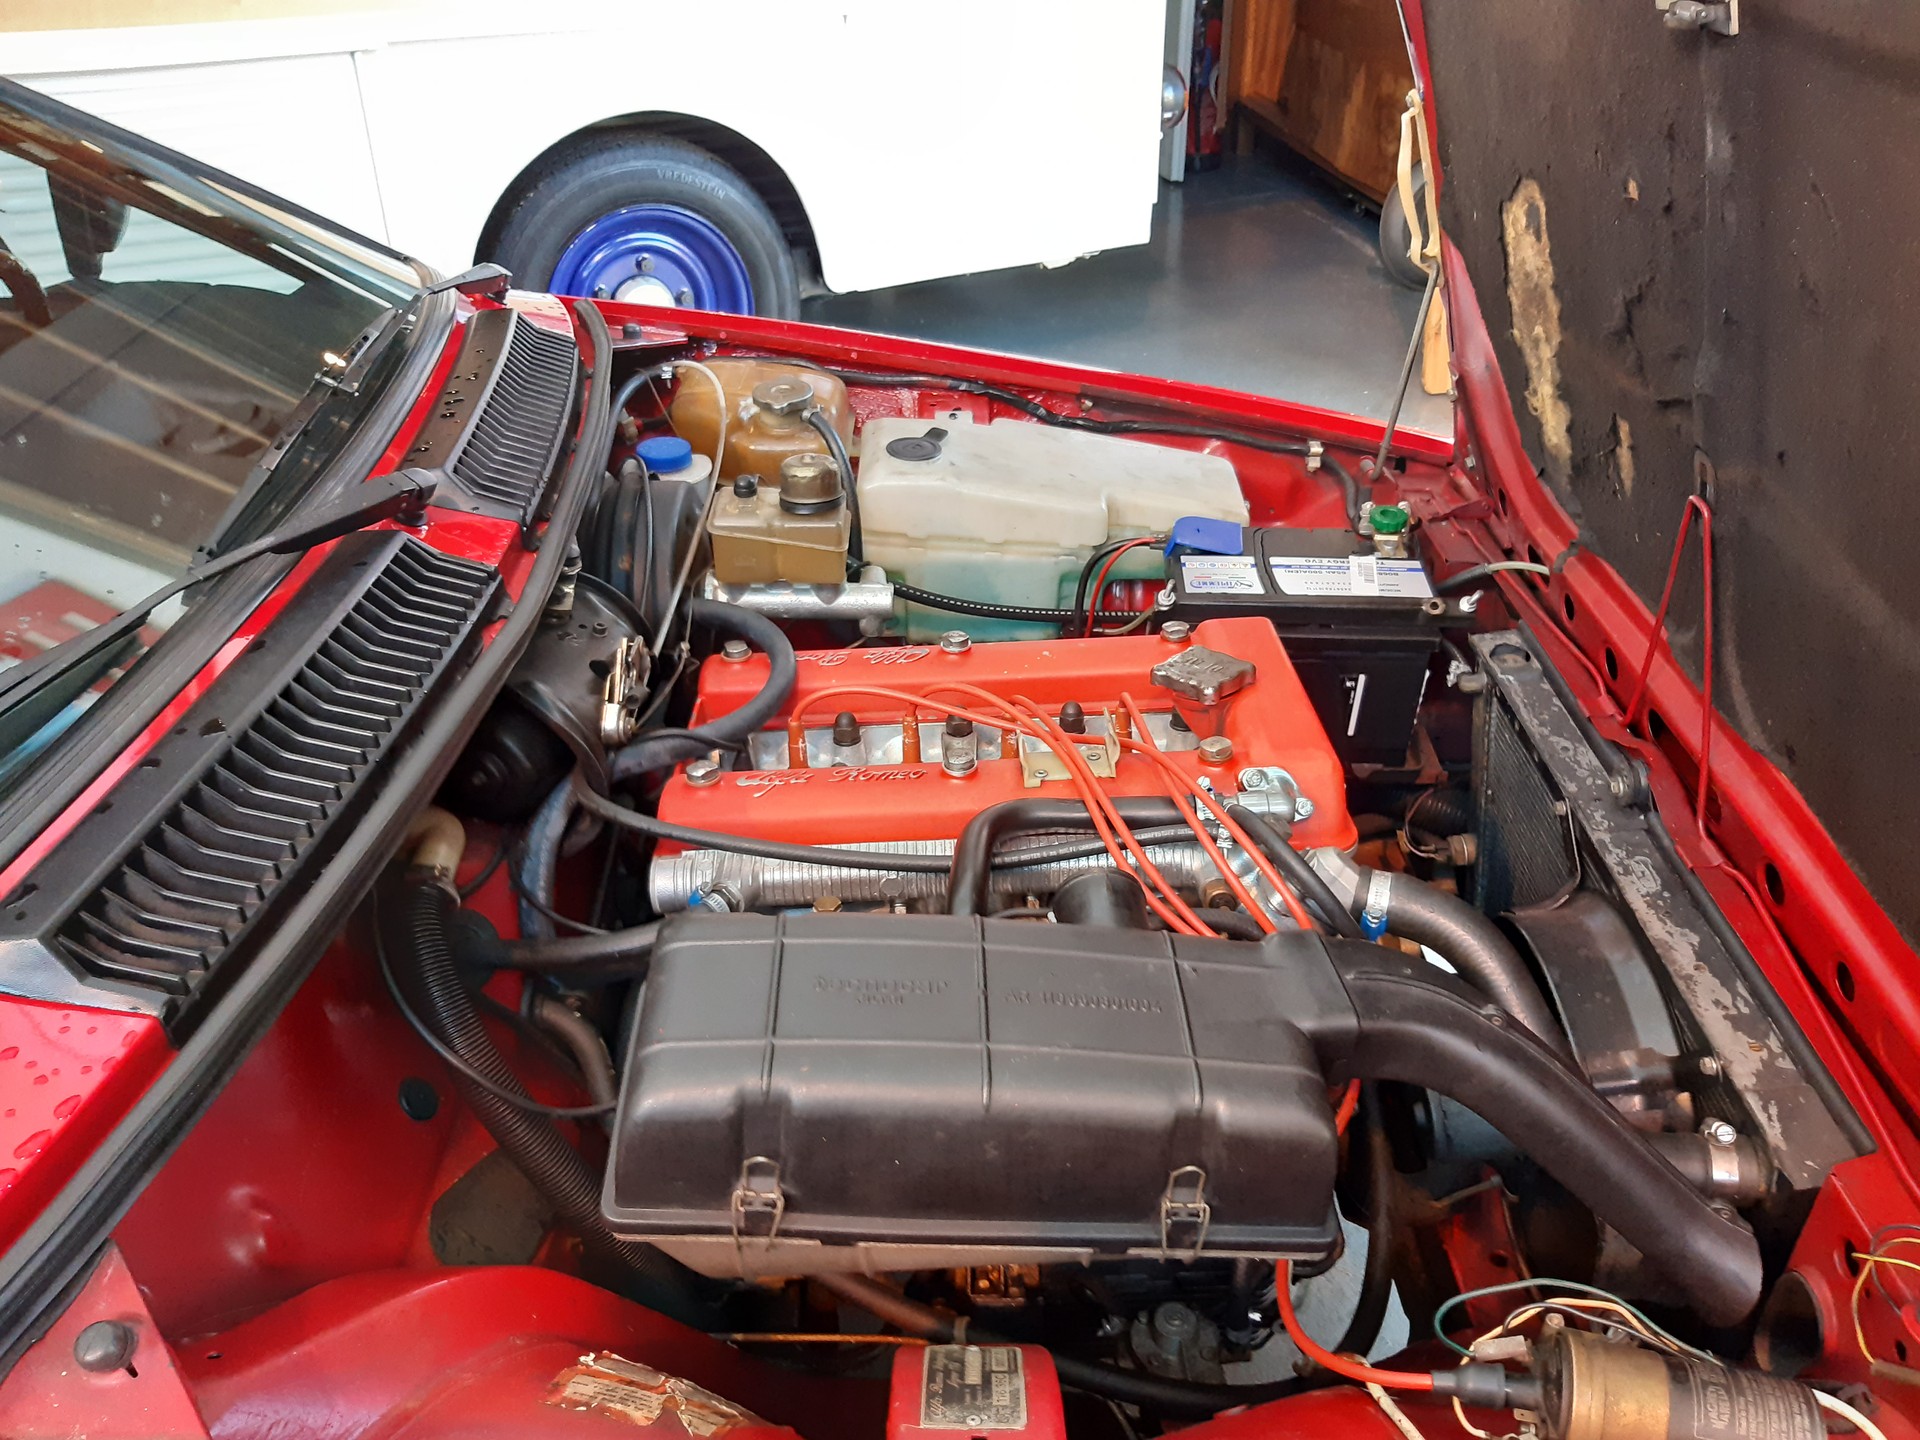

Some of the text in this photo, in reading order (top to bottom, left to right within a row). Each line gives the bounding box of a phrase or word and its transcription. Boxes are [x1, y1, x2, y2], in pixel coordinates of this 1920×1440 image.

[657, 167, 726, 199] VREDESTEIN
[863, 645, 930, 665] Alfa
[736, 767, 928, 798] Alfa Romeo
